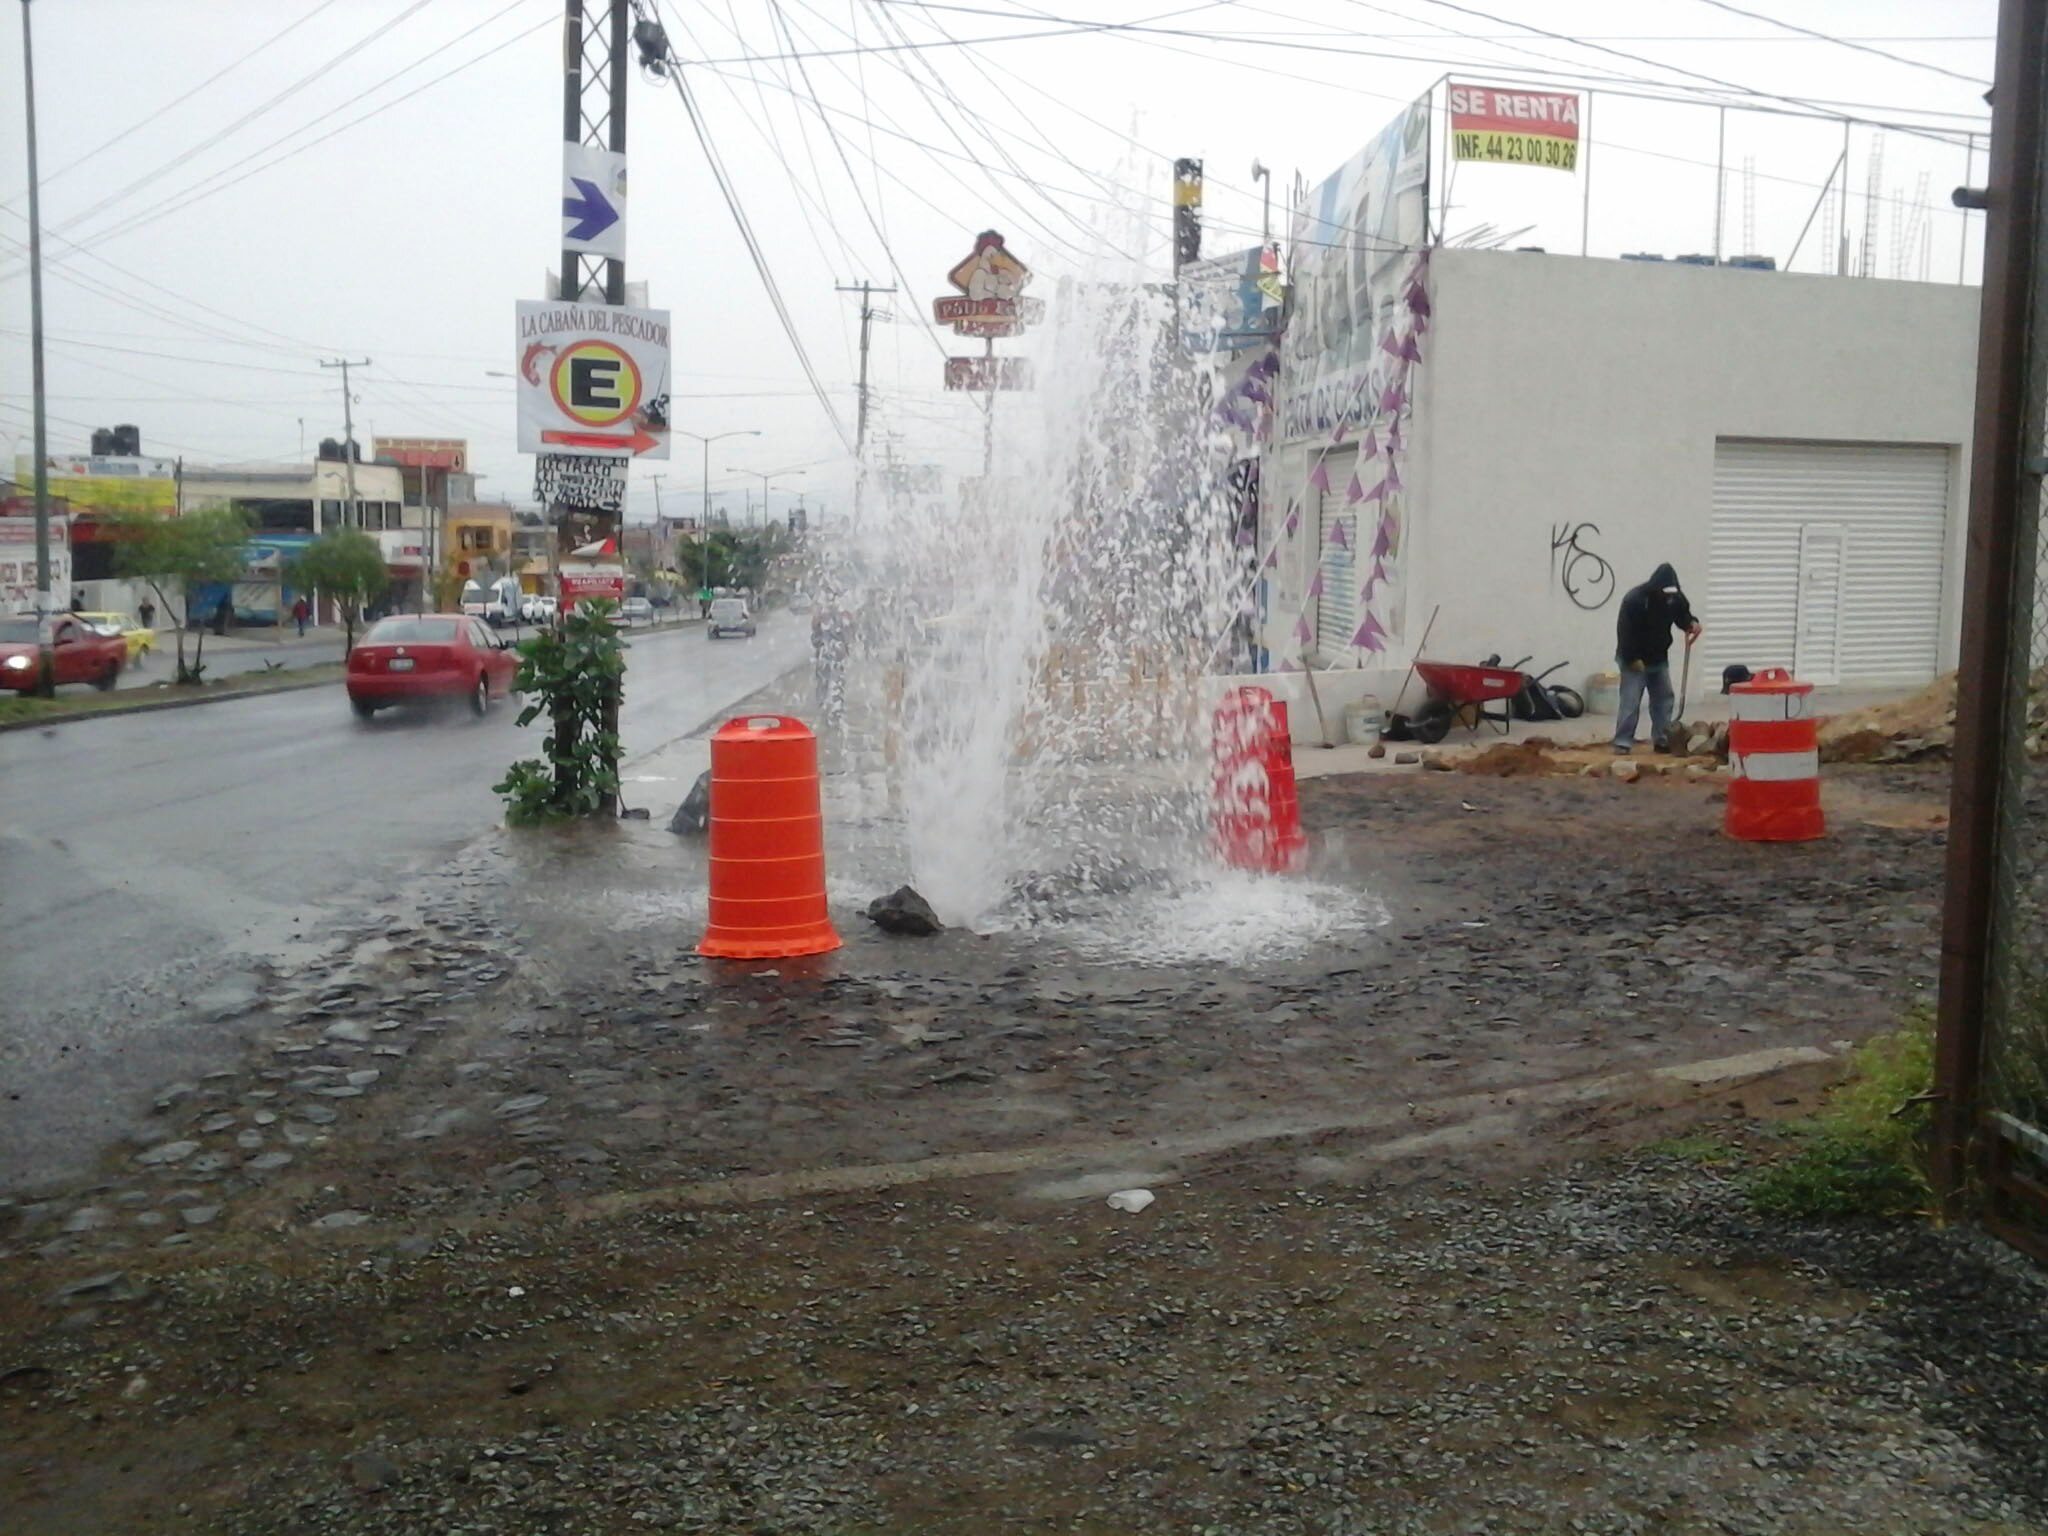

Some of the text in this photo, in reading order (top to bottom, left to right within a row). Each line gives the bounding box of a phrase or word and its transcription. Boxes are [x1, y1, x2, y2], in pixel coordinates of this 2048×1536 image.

[1452, 88, 1578, 125] SE RENTA
[1456, 134, 1482, 159] INF.
[1487, 135, 1503, 160] 44
[1507, 137, 1523, 161] 23
[1527, 138, 1542, 163] 00
[1546, 140, 1560, 166] 30
[521, 305, 669, 349] LA CABAÑA DEL PESCADOR
[571, 358, 621, 409] E
